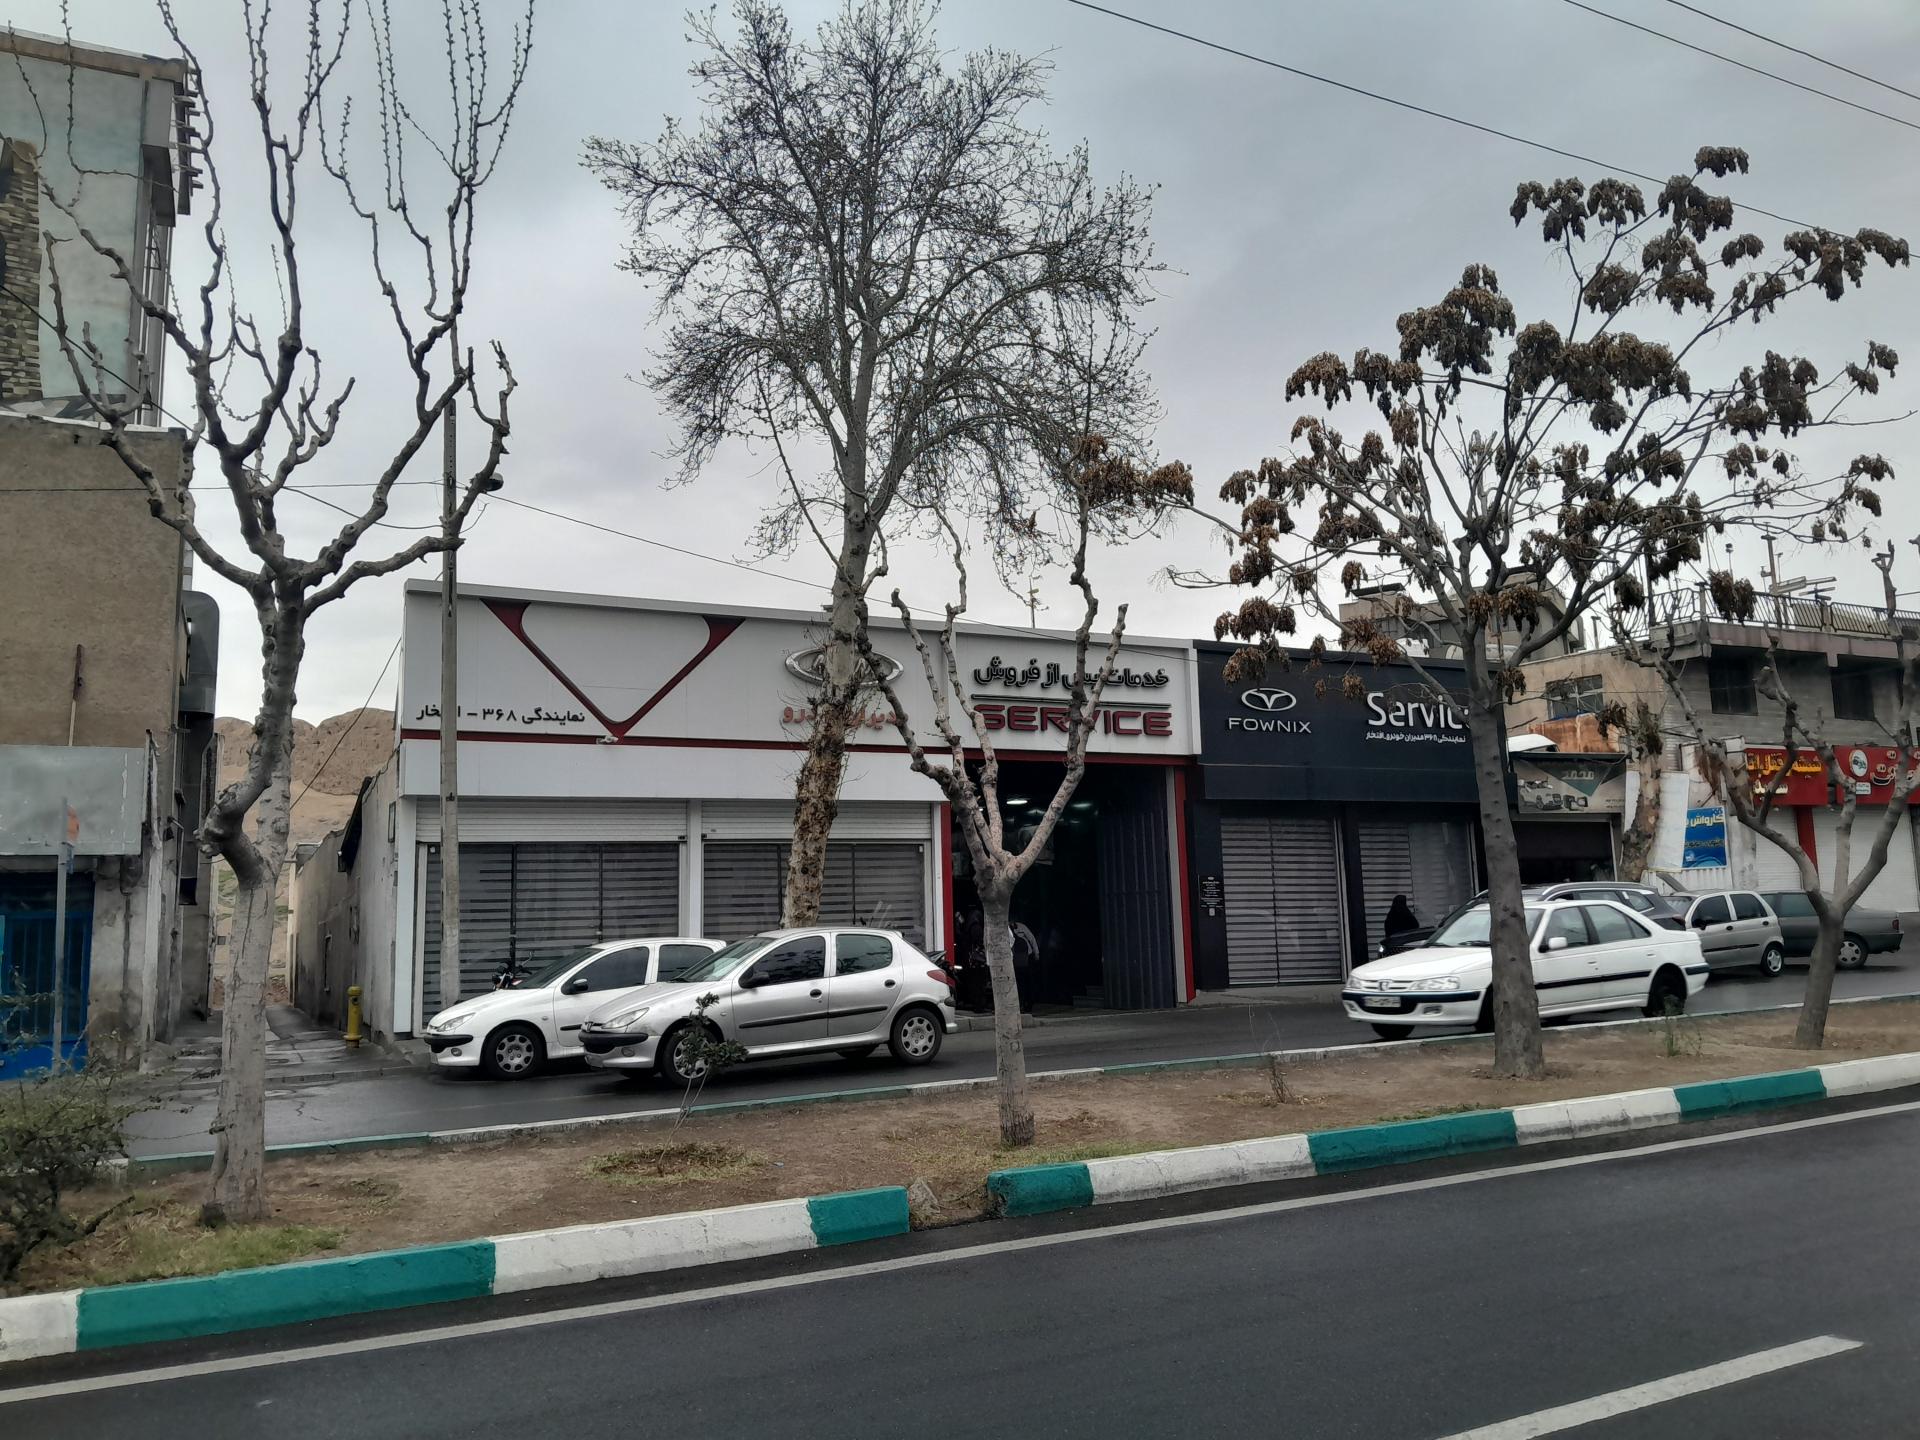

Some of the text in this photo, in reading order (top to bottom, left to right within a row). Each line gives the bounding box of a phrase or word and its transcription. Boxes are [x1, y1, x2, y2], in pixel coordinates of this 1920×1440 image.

[973, 656, 1041, 687] فروش
[1041, 661, 1060, 689] از
[416, 704, 461, 721] اخار
[482, 708, 518, 721] ۳۶۸
[522, 707, 586, 726] نمایندگی
[1366, 691, 1470, 729] Servic
[1228, 717, 1312, 734] FOWNIX
[1437, 733, 1467, 744] نمایندگی
